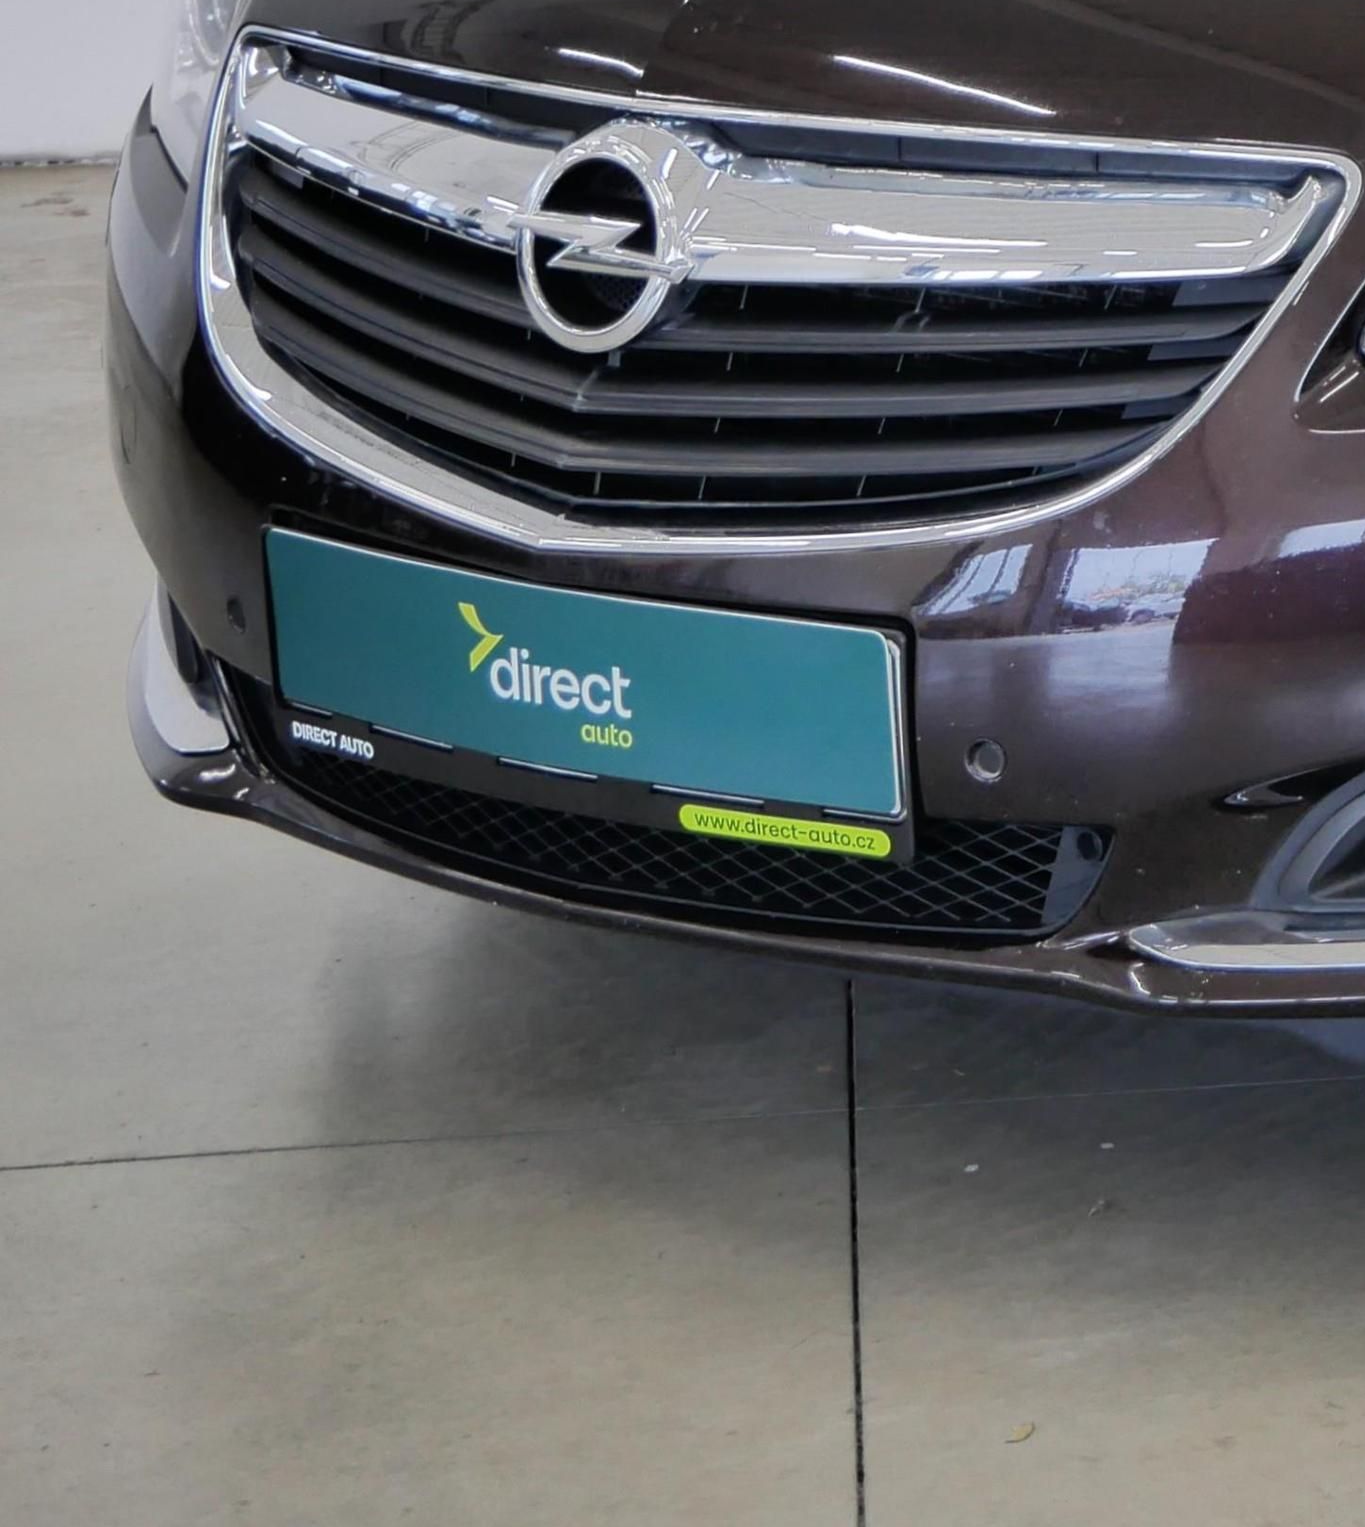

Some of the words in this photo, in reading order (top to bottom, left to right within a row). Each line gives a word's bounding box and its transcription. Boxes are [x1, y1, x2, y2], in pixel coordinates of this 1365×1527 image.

[490, 647, 632, 719] direct
[292, 719, 338, 748] DIRECT
[340, 734, 375, 760] AUTO
[581, 723, 633, 749] auto
[694, 812, 876, 851] www.direct-auto.cz
